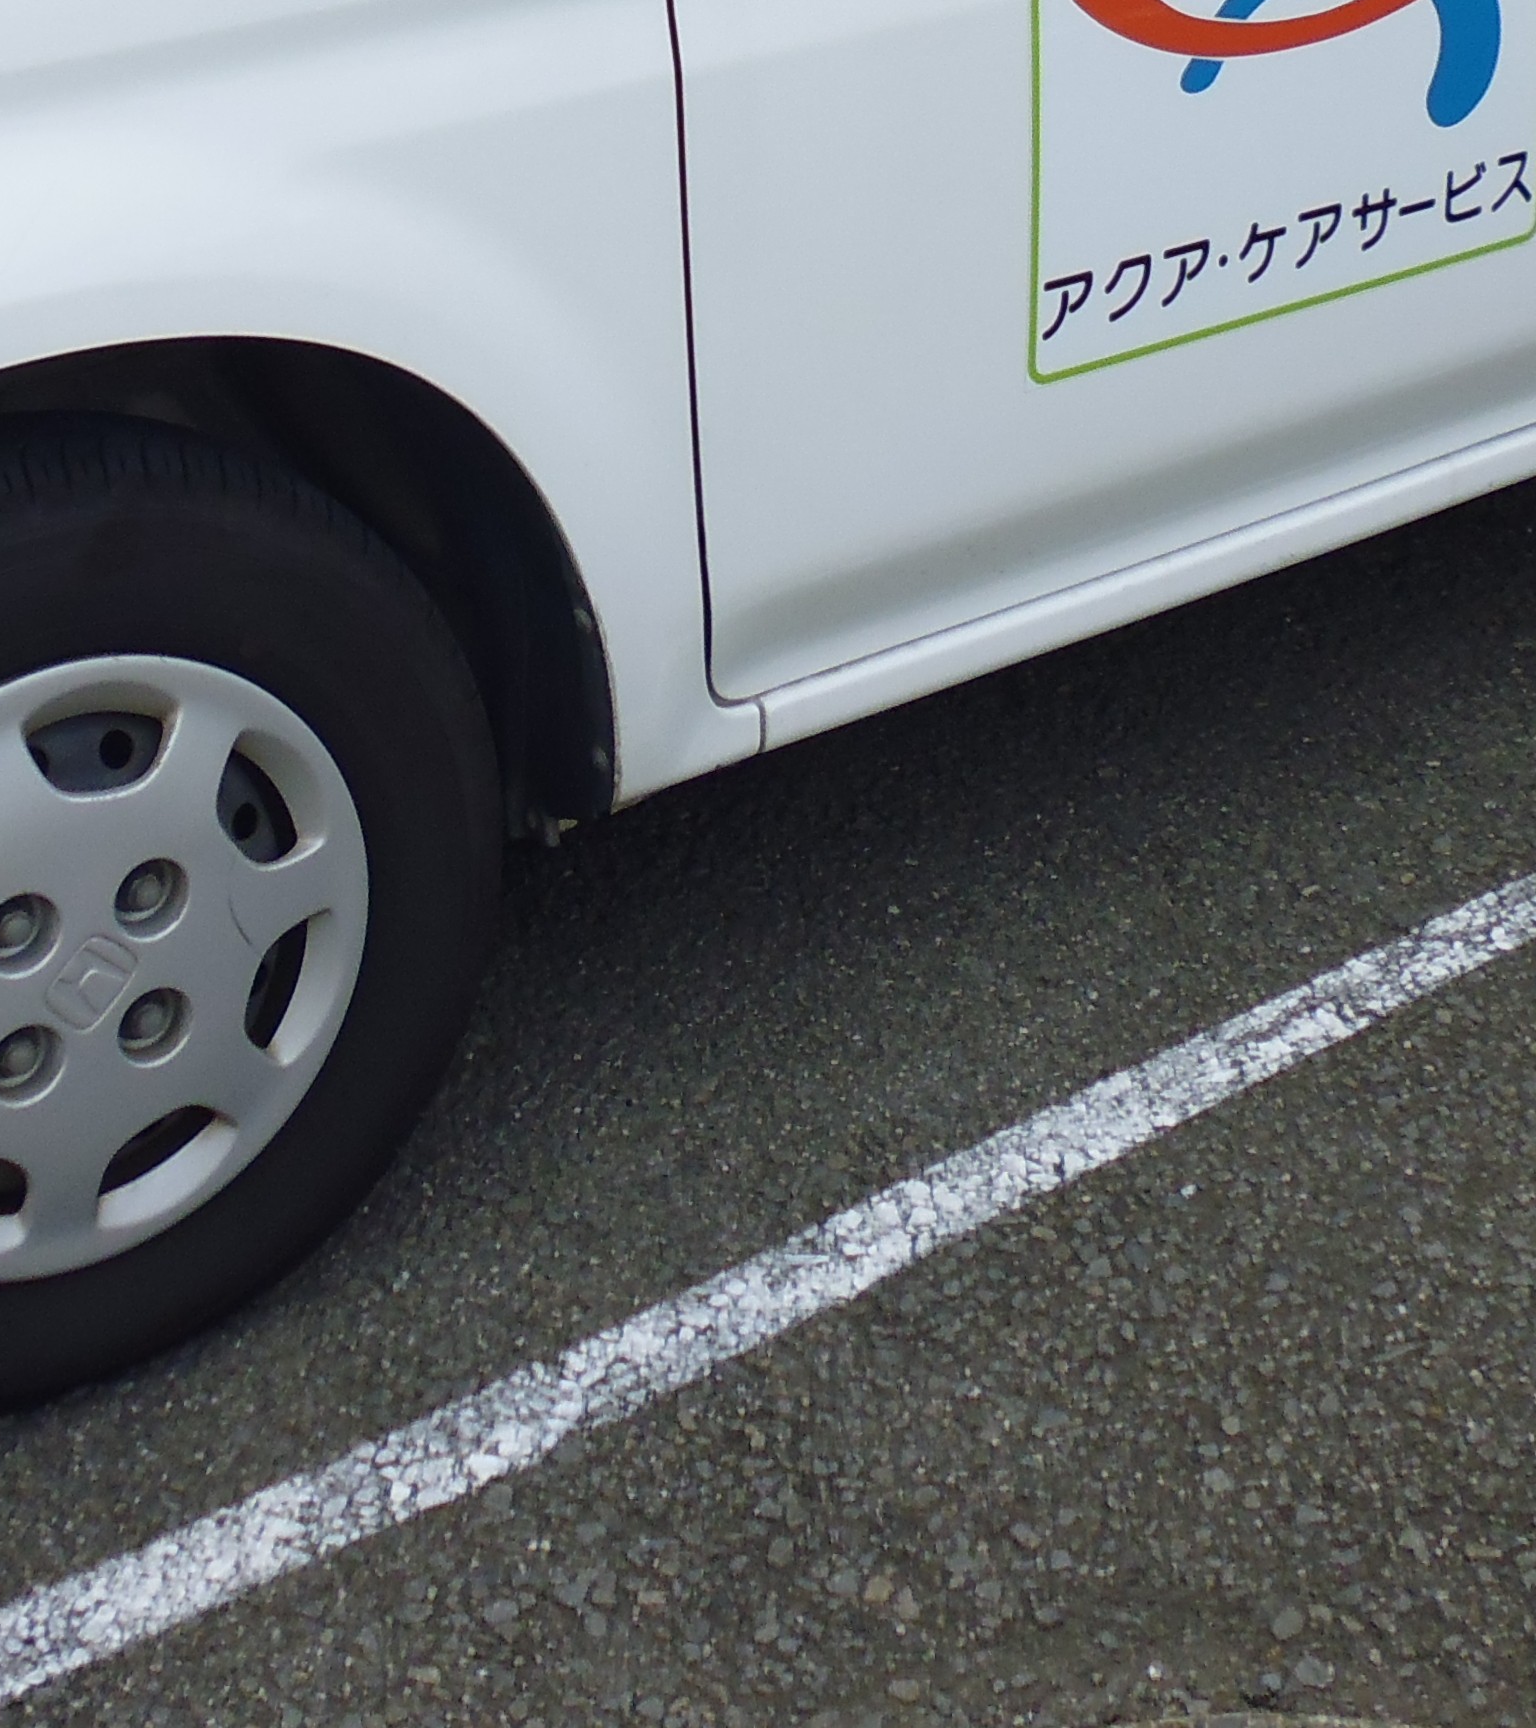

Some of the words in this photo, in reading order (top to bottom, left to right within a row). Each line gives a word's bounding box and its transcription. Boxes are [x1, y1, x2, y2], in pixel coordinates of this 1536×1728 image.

[1041, 150, 1534, 343] アクア・ケアサービス
